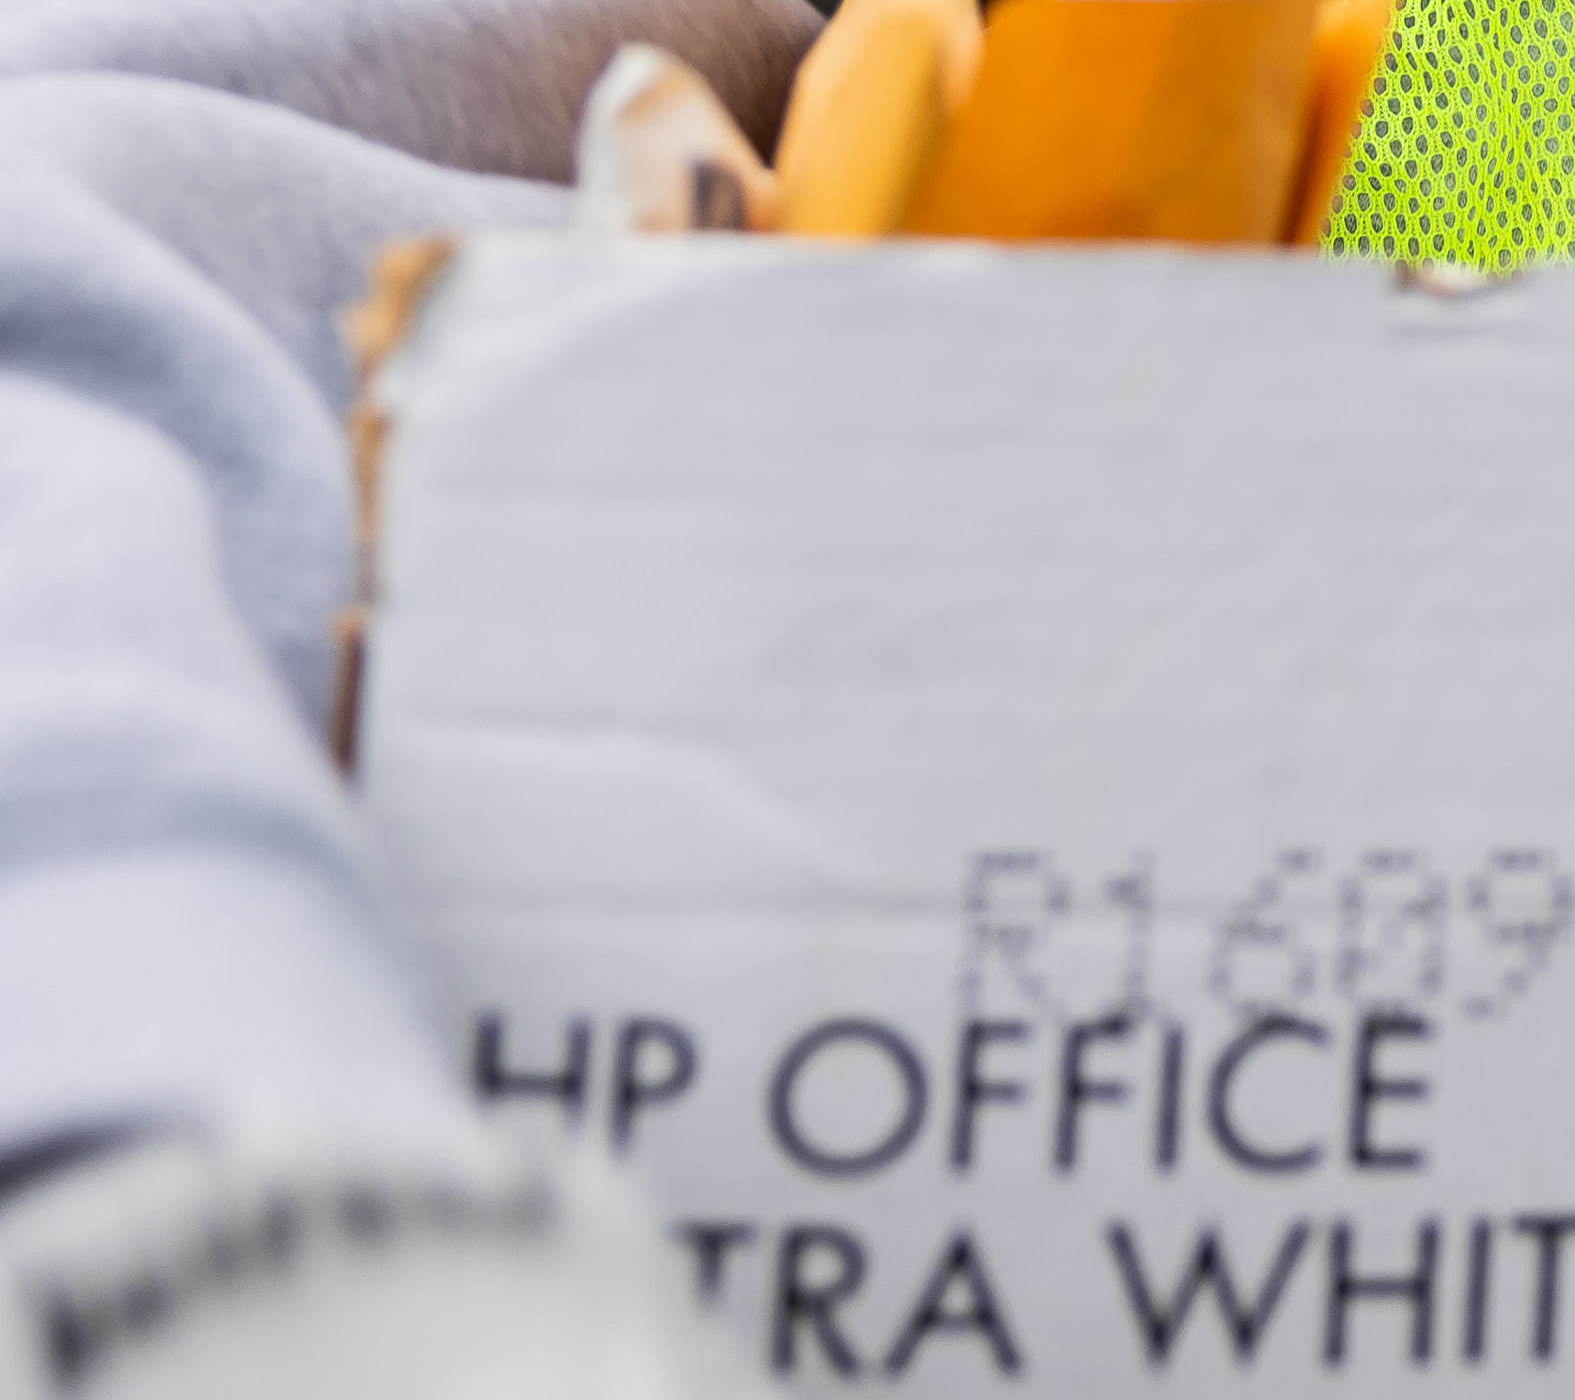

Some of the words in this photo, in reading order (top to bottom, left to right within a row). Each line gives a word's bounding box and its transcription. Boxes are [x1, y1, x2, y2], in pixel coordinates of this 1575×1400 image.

[466, 1011, 699, 1161] HP
[763, 1011, 1440, 1179] OFFICE
[668, 1217, 1027, 1382] TRA
